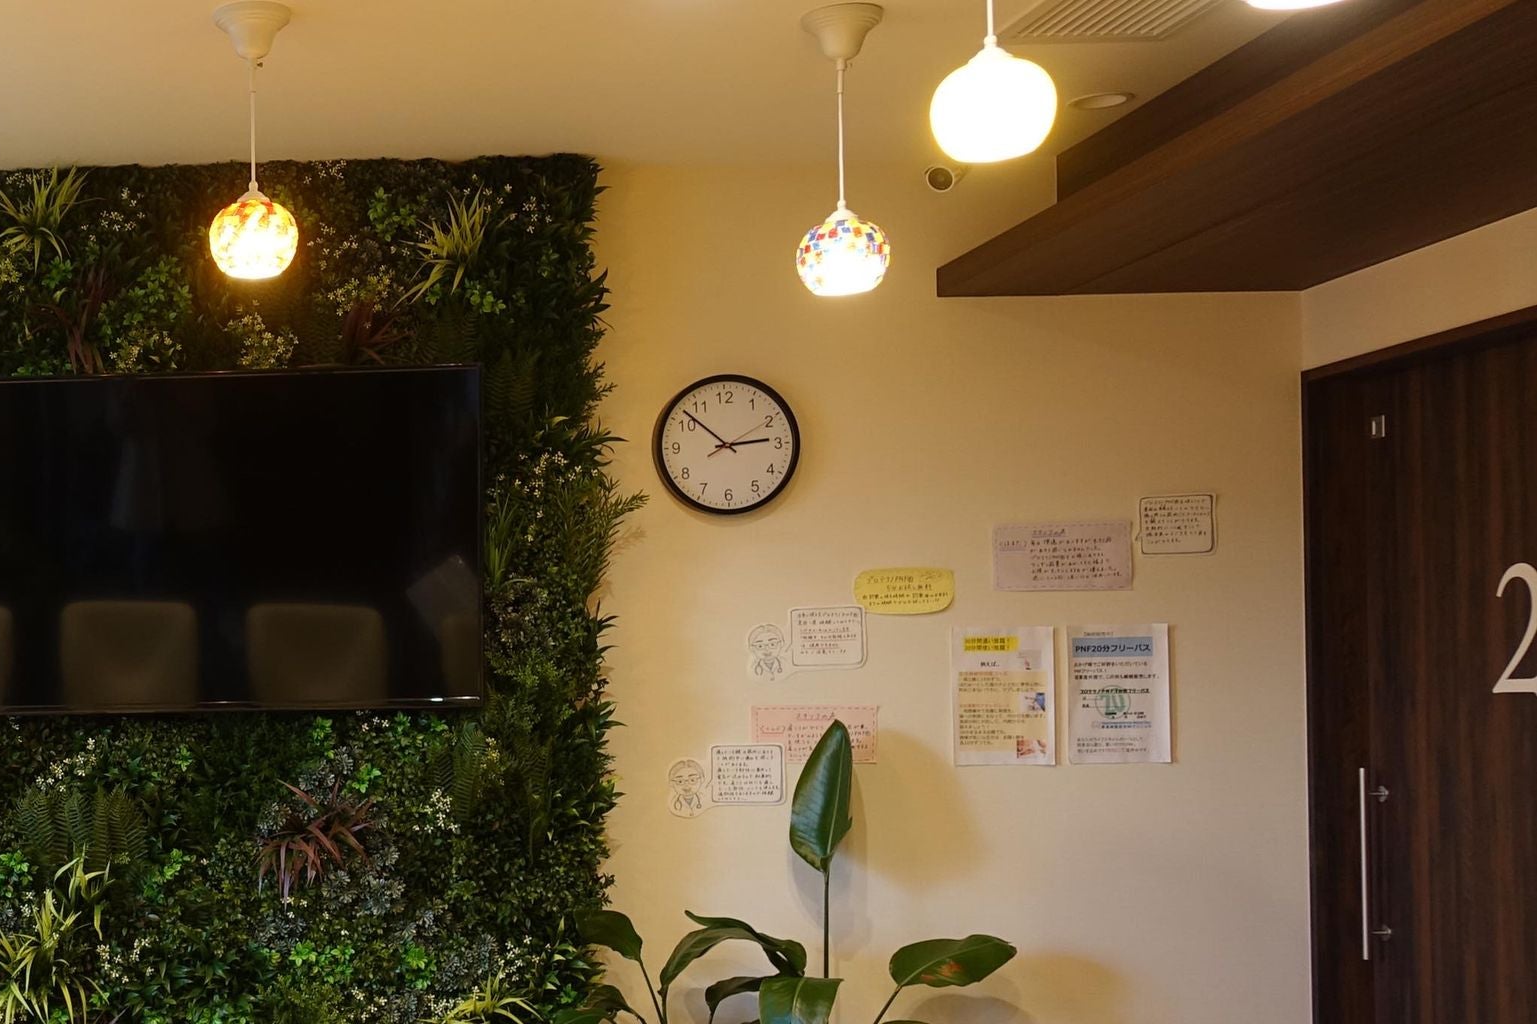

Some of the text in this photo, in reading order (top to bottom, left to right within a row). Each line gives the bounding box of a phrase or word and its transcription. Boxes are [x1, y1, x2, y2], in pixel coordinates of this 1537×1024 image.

[716, 391, 734, 404] 12
[692, 400, 707, 413] 11
[748, 398, 755, 411] 1
[678, 418, 696, 432] 10
[764, 415, 774, 428] 2
[671, 442, 681, 454] 9
[774, 437, 783, 449] 3
[681, 467, 690, 480] 8
[766, 463, 775, 475] 4
[699, 483, 708, 495] 7
[751, 480, 760, 493] 5
[724, 489, 733, 501] 6
[1492, 562, 1537, 696] 2
[1075, 644, 1151, 652] PNF20分フリーパス
